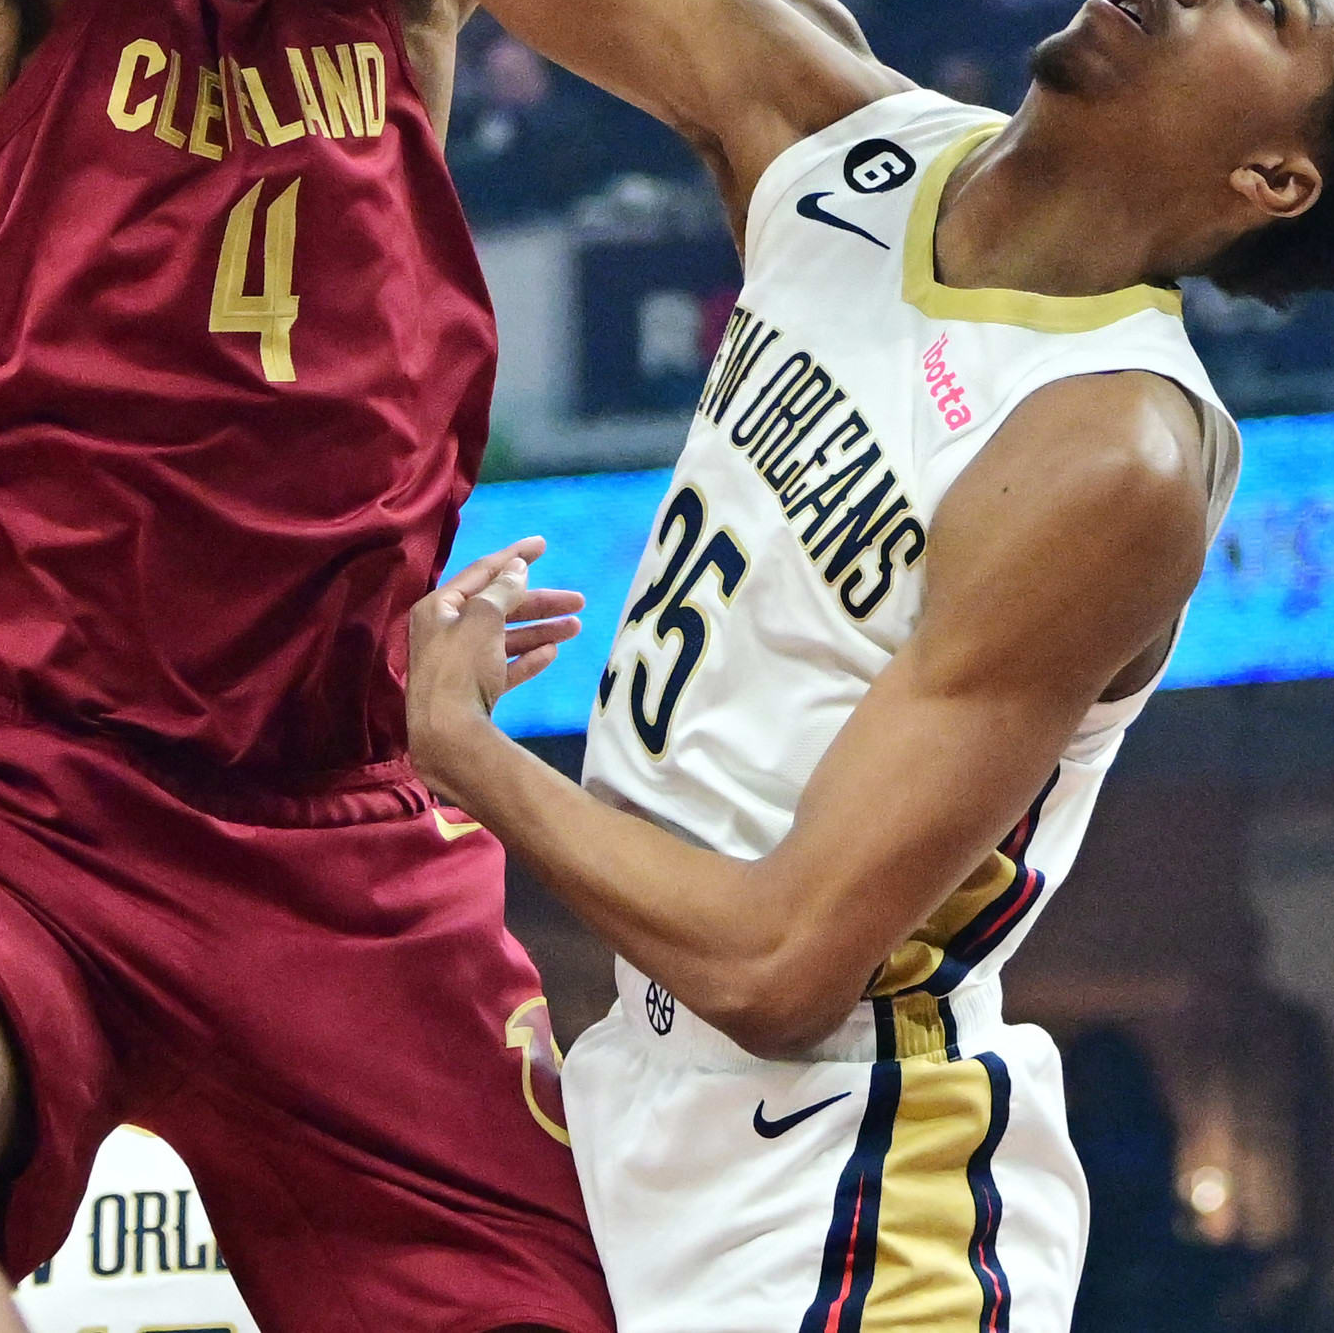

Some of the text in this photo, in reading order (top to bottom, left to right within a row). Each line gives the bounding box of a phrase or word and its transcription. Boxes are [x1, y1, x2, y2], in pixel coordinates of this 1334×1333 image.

[107, 38, 386, 162] CLEELAND
[861, 150, 908, 188] 6
[208, 176, 302, 383] 4
[923, 331, 973, 432] ibotta
[728, 349, 928, 623] ORLEANS
[598, 482, 751, 763] 25
[87, 1189, 231, 1279] ORL
